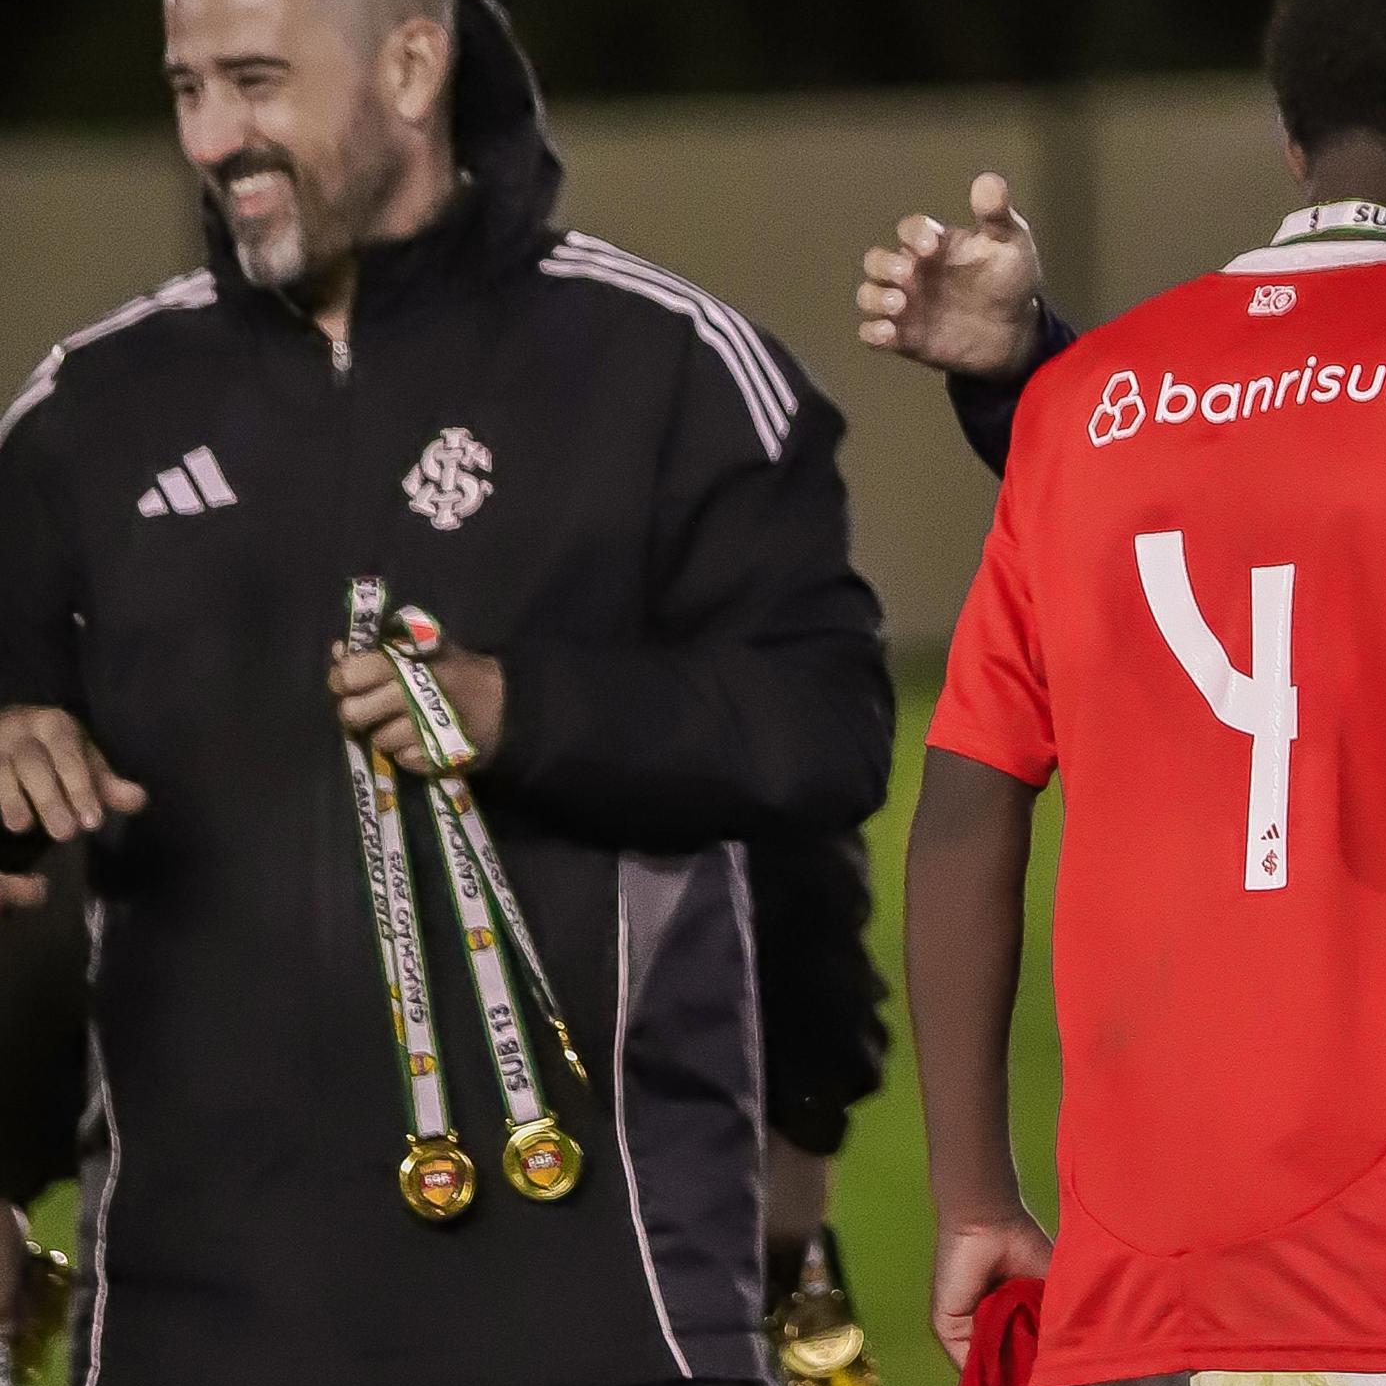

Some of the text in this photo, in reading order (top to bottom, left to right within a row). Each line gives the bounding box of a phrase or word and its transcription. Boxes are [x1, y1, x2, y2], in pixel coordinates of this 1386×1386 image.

[1134, 530, 1298, 891] 4
[488, 1002, 530, 1092] SUB 13
